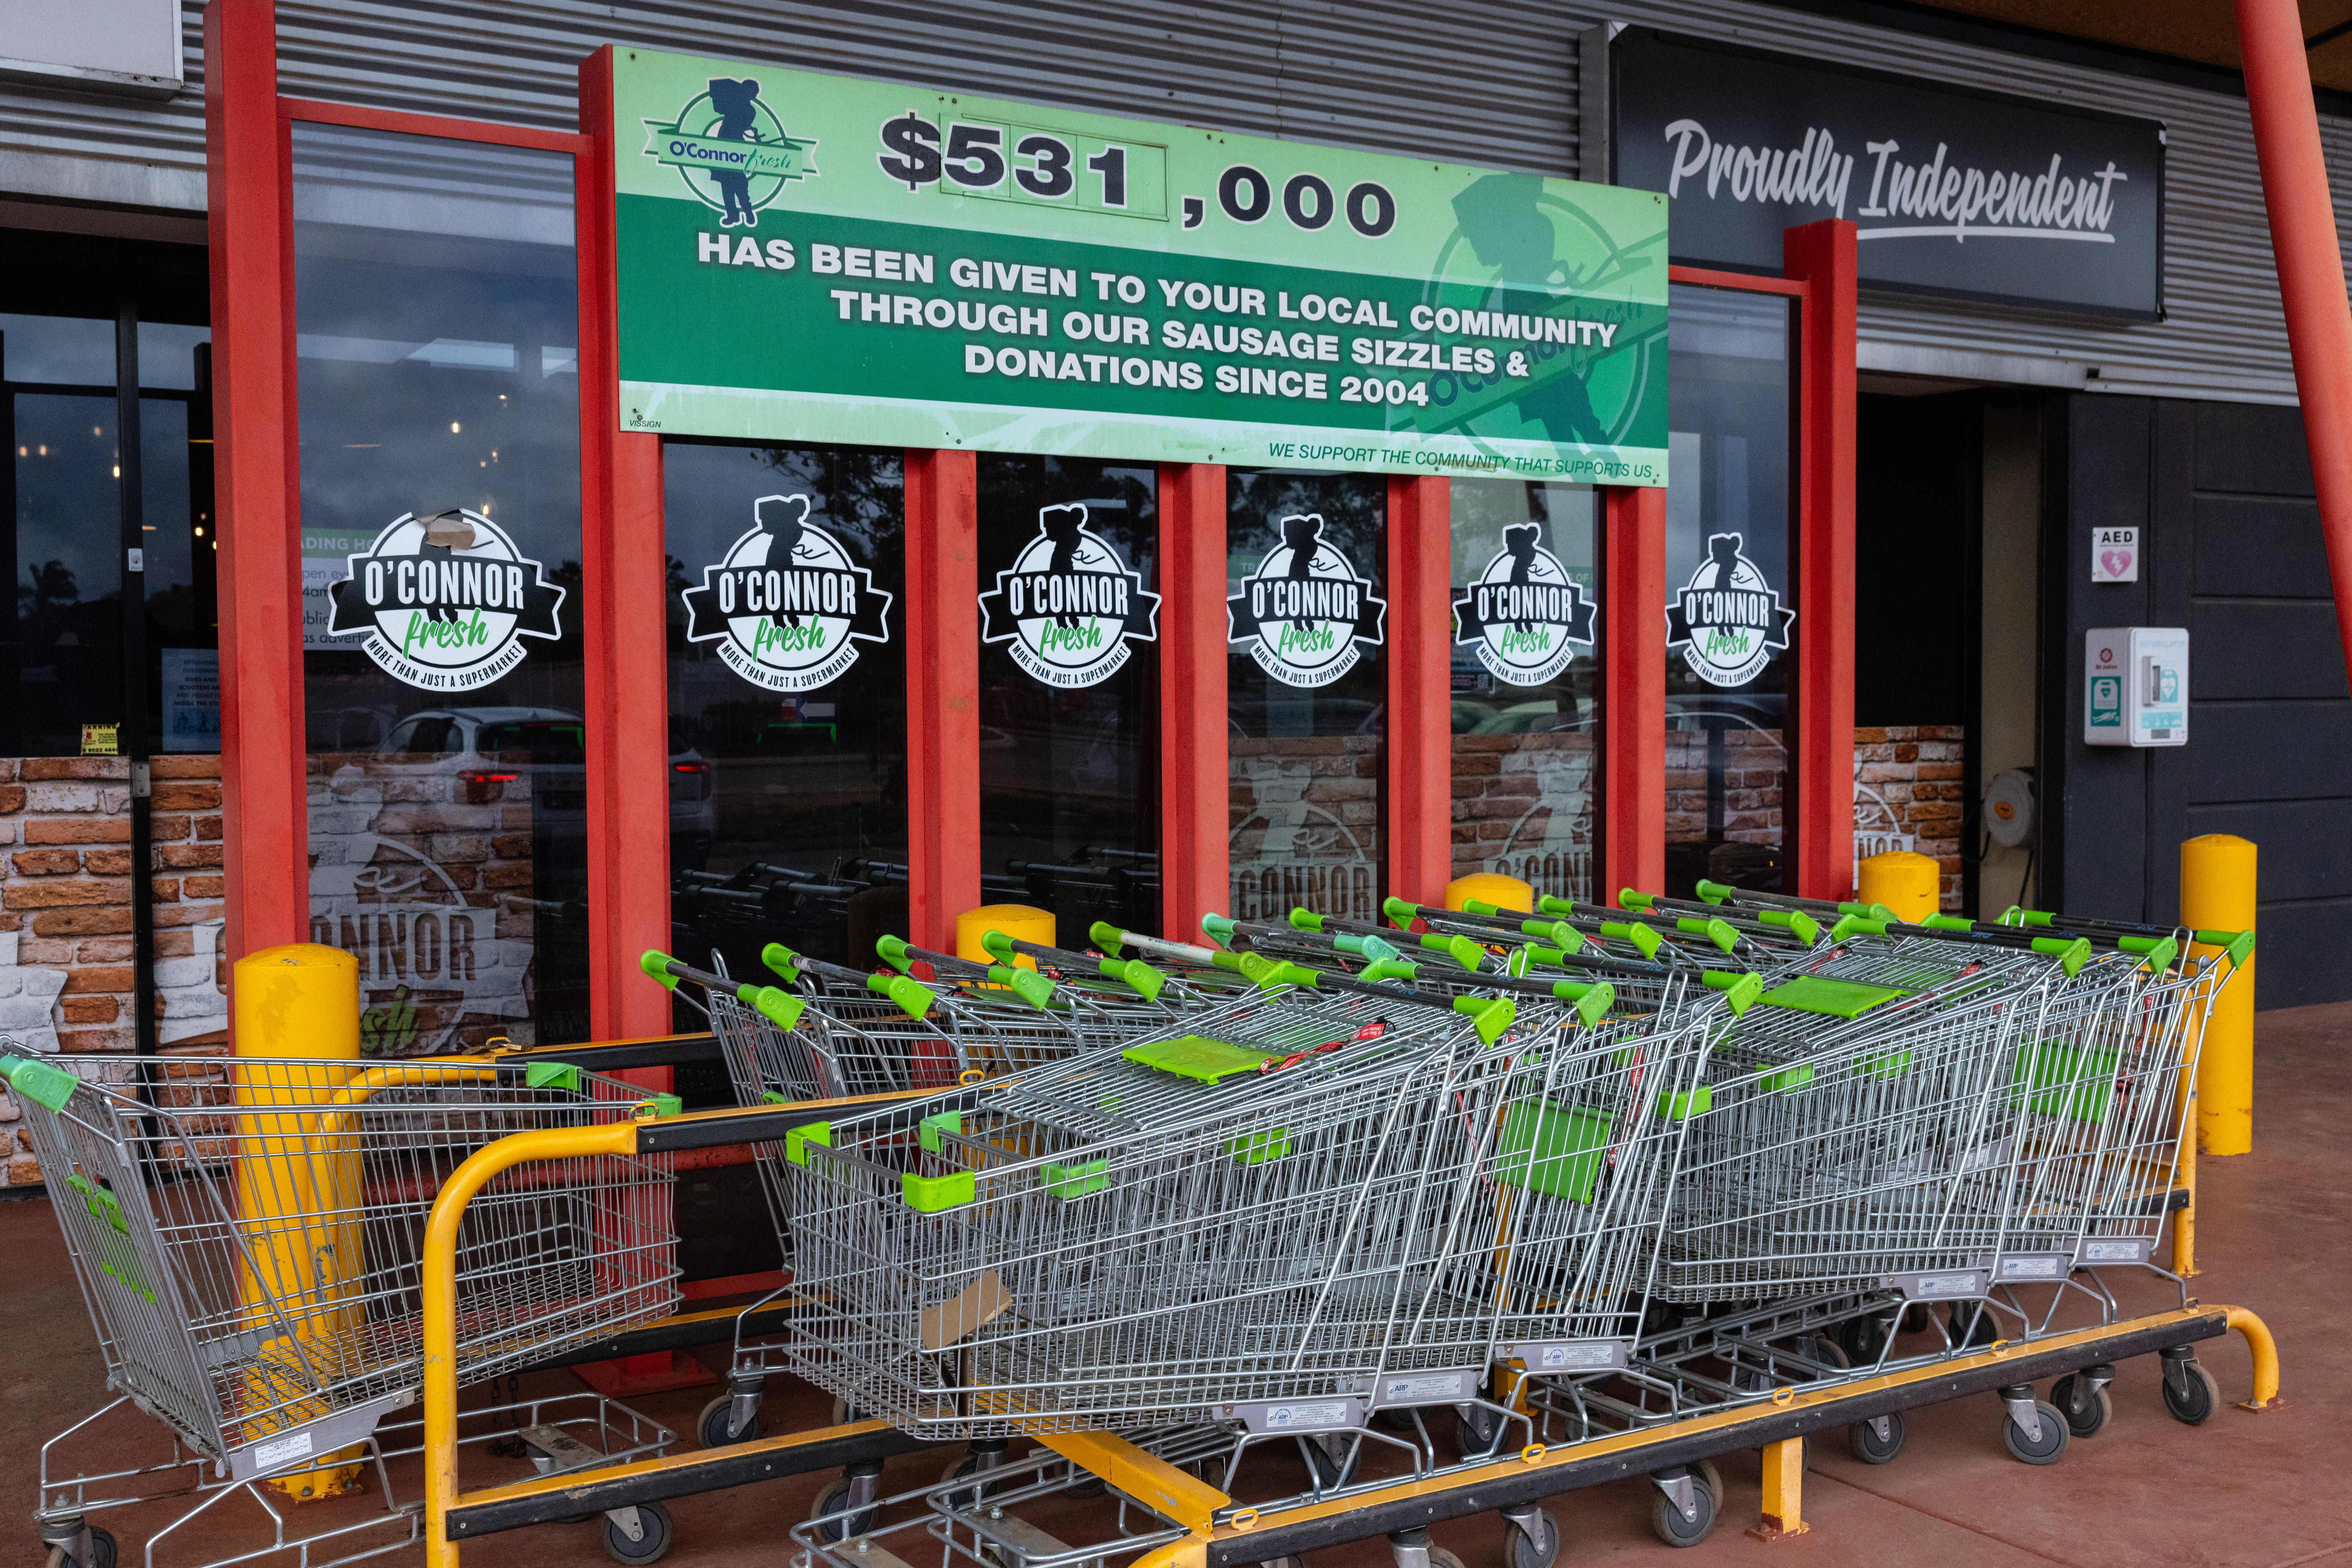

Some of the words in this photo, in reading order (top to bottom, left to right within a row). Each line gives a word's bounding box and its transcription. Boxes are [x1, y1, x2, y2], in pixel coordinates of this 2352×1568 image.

[669, 140, 747, 165] O'Connor
[743, 147, 791, 175] fresh
[1665, 118, 1854, 220] Proudly
[1858, 139, 2128, 243] Independent
[698, 232, 795, 270] HAS
[811, 243, 934, 284] BEEN
[949, 258, 1077, 297] GIVEN
[1090, 272, 1146, 304] TO
[1158, 278, 1266, 316] YOUR
[1279, 292, 1398, 328] LOCAL
[1410, 305, 1617, 348] COMMUNITY
[830, 290, 1048, 337] THROUGH
[1062, 311, 1149, 346] OUR
[1162, 320, 1339, 362] SAUSAGE
[1351, 335, 1495, 376] SIZZLES
[1507, 351, 1529, 377] &
[964, 345, 1203, 390] DONATIONS
[1215, 365, 1328, 400] SINCE
[1340, 376, 1429, 406] 2004
[1269, 443, 1295, 458] WE
[1299, 444, 1376, 463] SUPPORT
[1380, 449, 1412, 465] THE
[1415, 451, 1510, 470] COMMUNITY
[1514, 457, 1553, 472] THAT
[1555, 459, 1631, 477] SUPPORTS
[1633, 464, 1653, 478] US
[2102, 531, 2132, 543] AED
[365, 560, 524, 609] O'CONNOR
[720, 570, 856, 615] O'CONNOR
[1010, 575, 1128, 616] O'CONNOR
[1253, 580, 1359, 620] O'CONNOR
[1478, 585, 1573, 622] O'CONNOR
[1686, 592, 1769, 627] O'CONNOR
[403, 608, 489, 660] fresh
[752, 614, 826, 663] fresh
[1038, 615, 1103, 662] fresh
[1277, 618, 1335, 662] fresh
[1500, 621, 1551, 662] fresh
[1705, 626, 1751, 663] fresh
[367, 639, 392, 665] MORE
[393, 658, 417, 681] THAN
[421, 672, 446, 687] JUST
[450, 675, 455, 687] A
[460, 644, 524, 686] SUPERMARKET
[722, 643, 743, 668] MORE
[743, 663, 765, 683] THAN
[767, 674, 790, 688] JUST
[793, 678, 798, 688] A
[801, 647, 855, 687] SUPERMARKET
[1012, 644, 1030, 666] MORE
[1031, 661, 1049, 680] THAN
[1052, 673, 1071, 685] JUST
[1074, 675, 1079, 684] A
[1081, 645, 1128, 683] SUPERMARKET
[1254, 645, 1269, 666] MORE
[1270, 662, 1286, 680] THAN
[1289, 673, 1306, 684] JUST
[1309, 675, 1312, 684] A
[1315, 648, 1358, 683] SUPERMARKET
[1479, 647, 1494, 667] MORE
[1494, 663, 1508, 679] THAN
[1510, 672, 1525, 683] JUST
[1534, 649, 1571, 682] SUPERMARKET
[1686, 648, 1699, 669] MORE
[1699, 664, 1712, 679] THAN
[1714, 672, 1727, 683] JUST
[1734, 652, 1768, 682] SUPERMARKET
